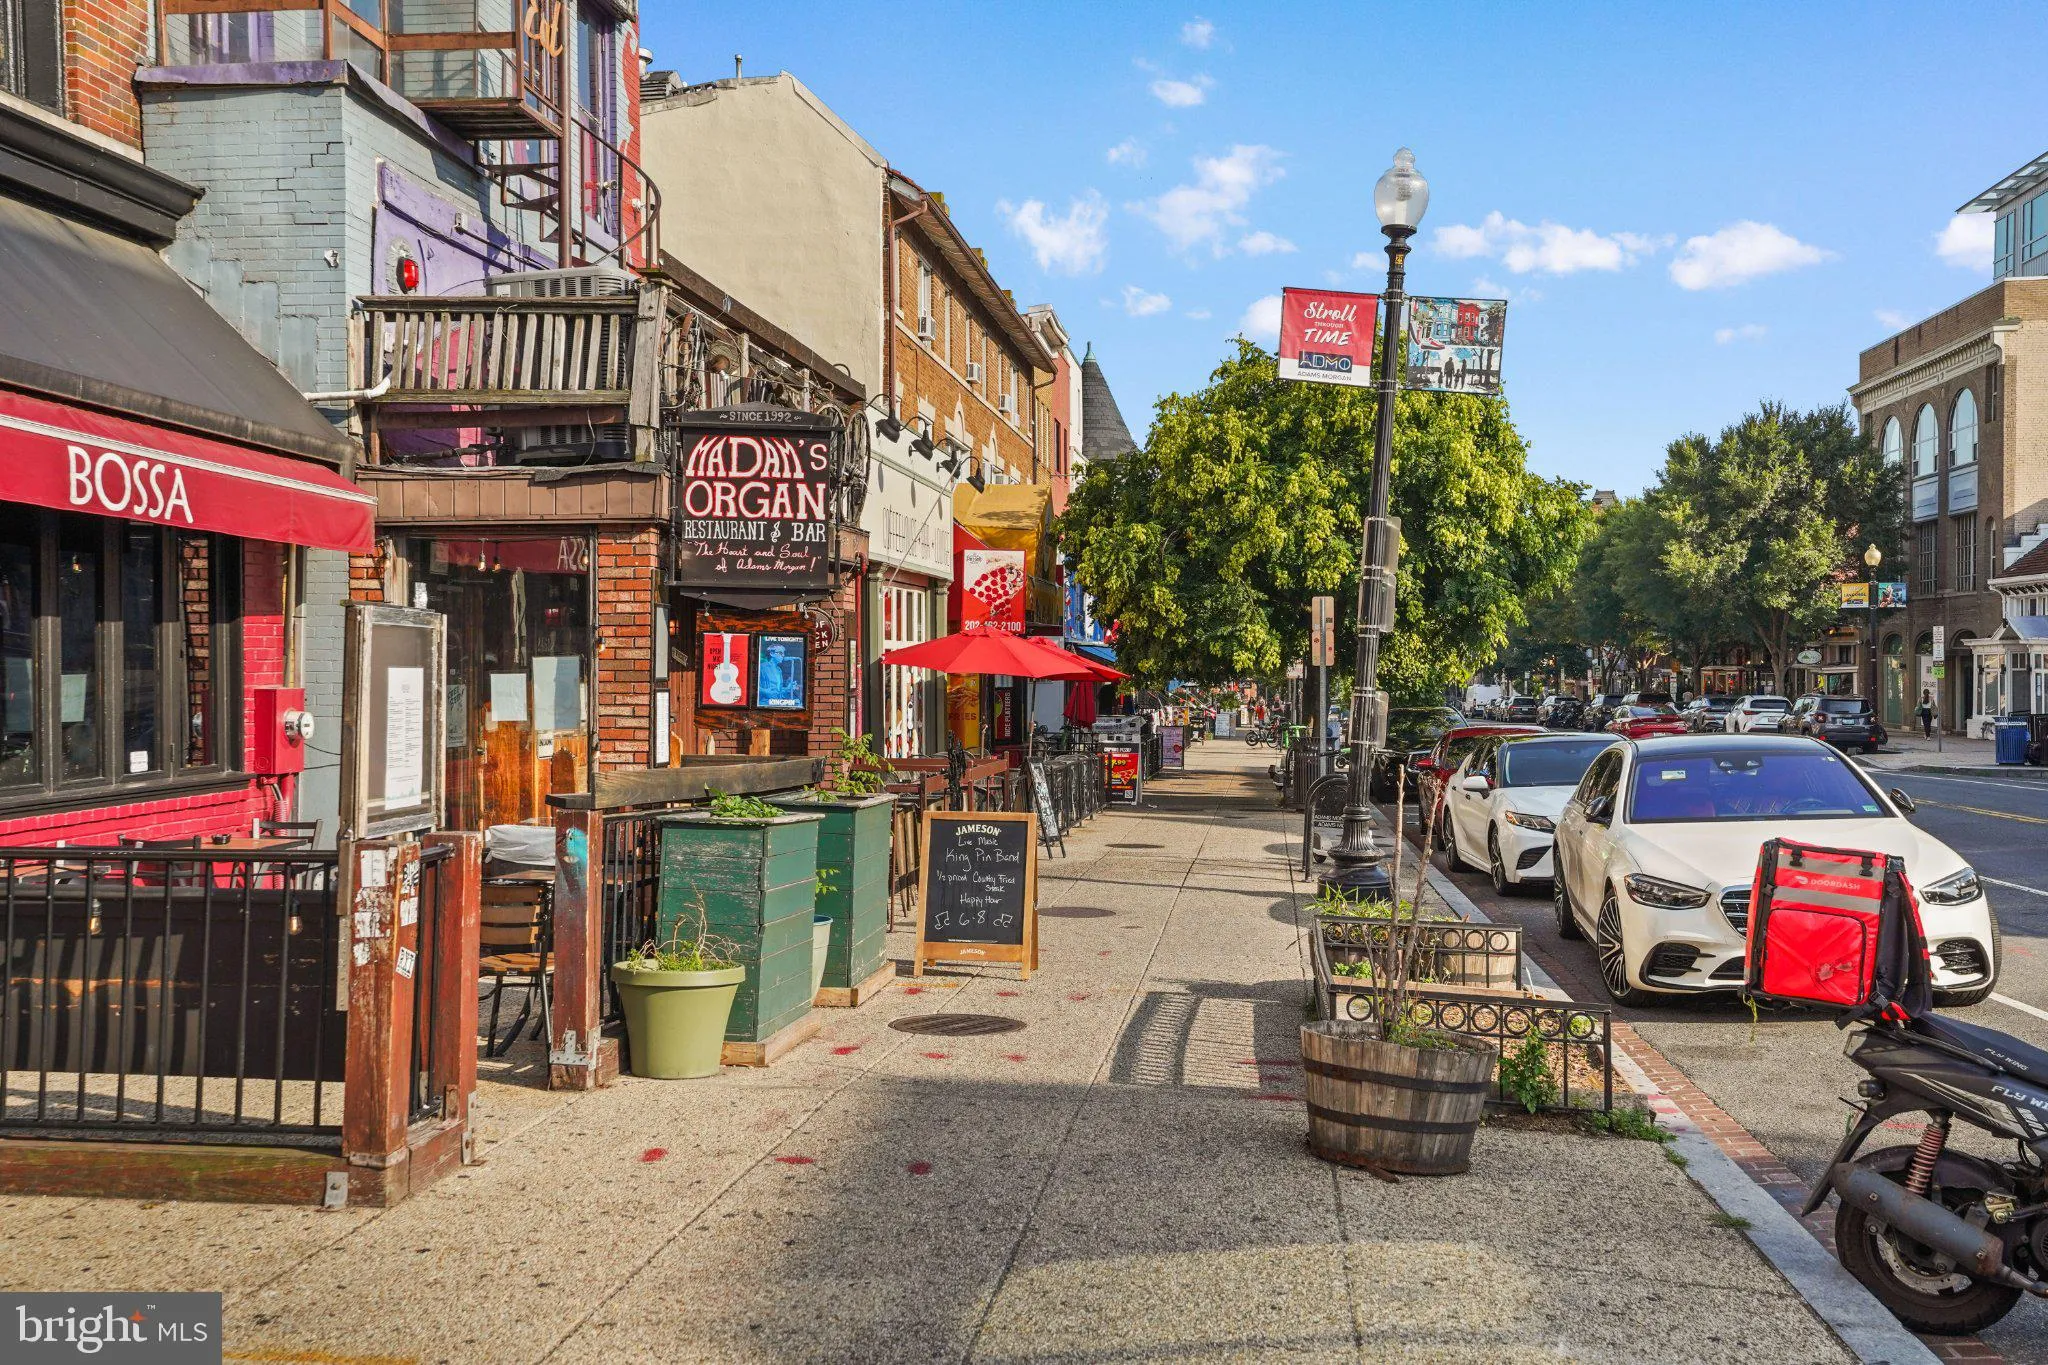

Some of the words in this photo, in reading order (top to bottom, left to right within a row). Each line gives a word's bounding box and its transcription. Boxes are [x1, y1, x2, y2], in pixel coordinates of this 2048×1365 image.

[1304, 301, 1357, 322] Stroll
[1304, 328, 1352, 346] TIME
[1299, 350, 1351, 371] ADMO
[1297, 371, 1321, 379] ADAMS
[1322, 373, 1351, 381] MORGAN
[729, 411, 763, 422] SINCE
[765, 411, 792, 423] 1992
[685, 436, 828, 479] MADAM'S
[67, 445, 194, 524] BOSSA
[684, 480, 826, 521] ORGAN
[683, 520, 767, 541] RESTAURANT
[791, 522, 826, 543] BAR
[714, 542, 748, 557] Heart
[755, 545, 775, 558] and
[779, 543, 809, 559] Soul
[715, 557, 728, 573] of
[736, 557, 772, 571] Adams
[955, 824, 1002, 836] JAMESON
[958, 837, 972, 847] Live
[978, 837, 998, 846] Music
[945, 847, 972, 872] King
[975, 848, 992, 863] Pin
[994, 849, 1020, 863] Band
[1810, 879, 1861, 890] DOORDASH
[959, 893, 984, 907] Happy
[959, 948, 986, 956] JAMESON
[1991, 1085, 2027, 1101] FLY
